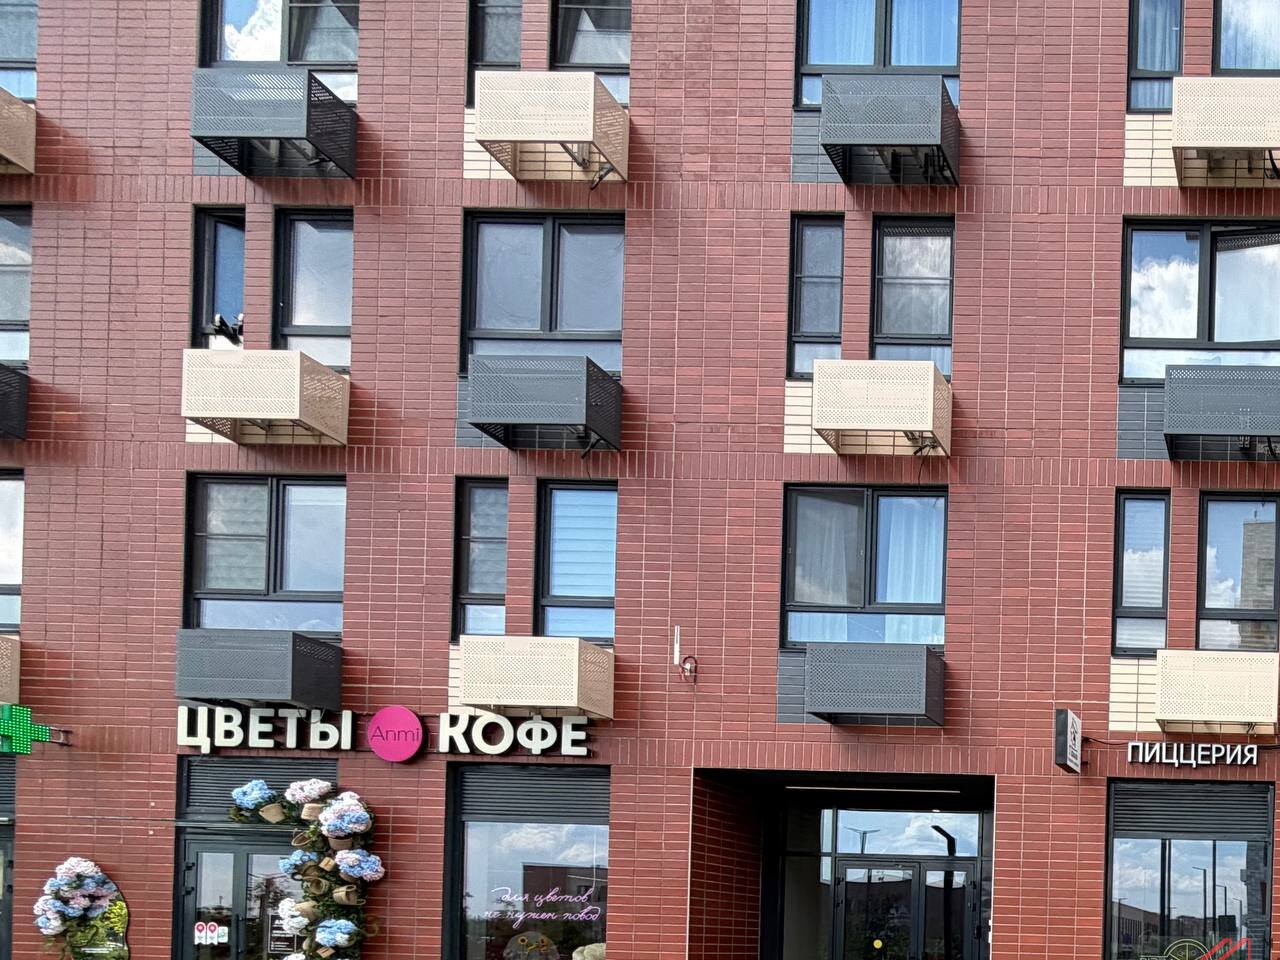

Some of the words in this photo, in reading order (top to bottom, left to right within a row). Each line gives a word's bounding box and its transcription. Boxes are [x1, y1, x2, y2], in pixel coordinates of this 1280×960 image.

[177, 705, 352, 754] ЦВЕТЫ
[371, 725, 420, 742] Anmi
[438, 712, 588, 755] КОФЕ
[1128, 742, 1258, 768] ПИЦЦЕРИЯ
[563, 905, 601, 920] повод
